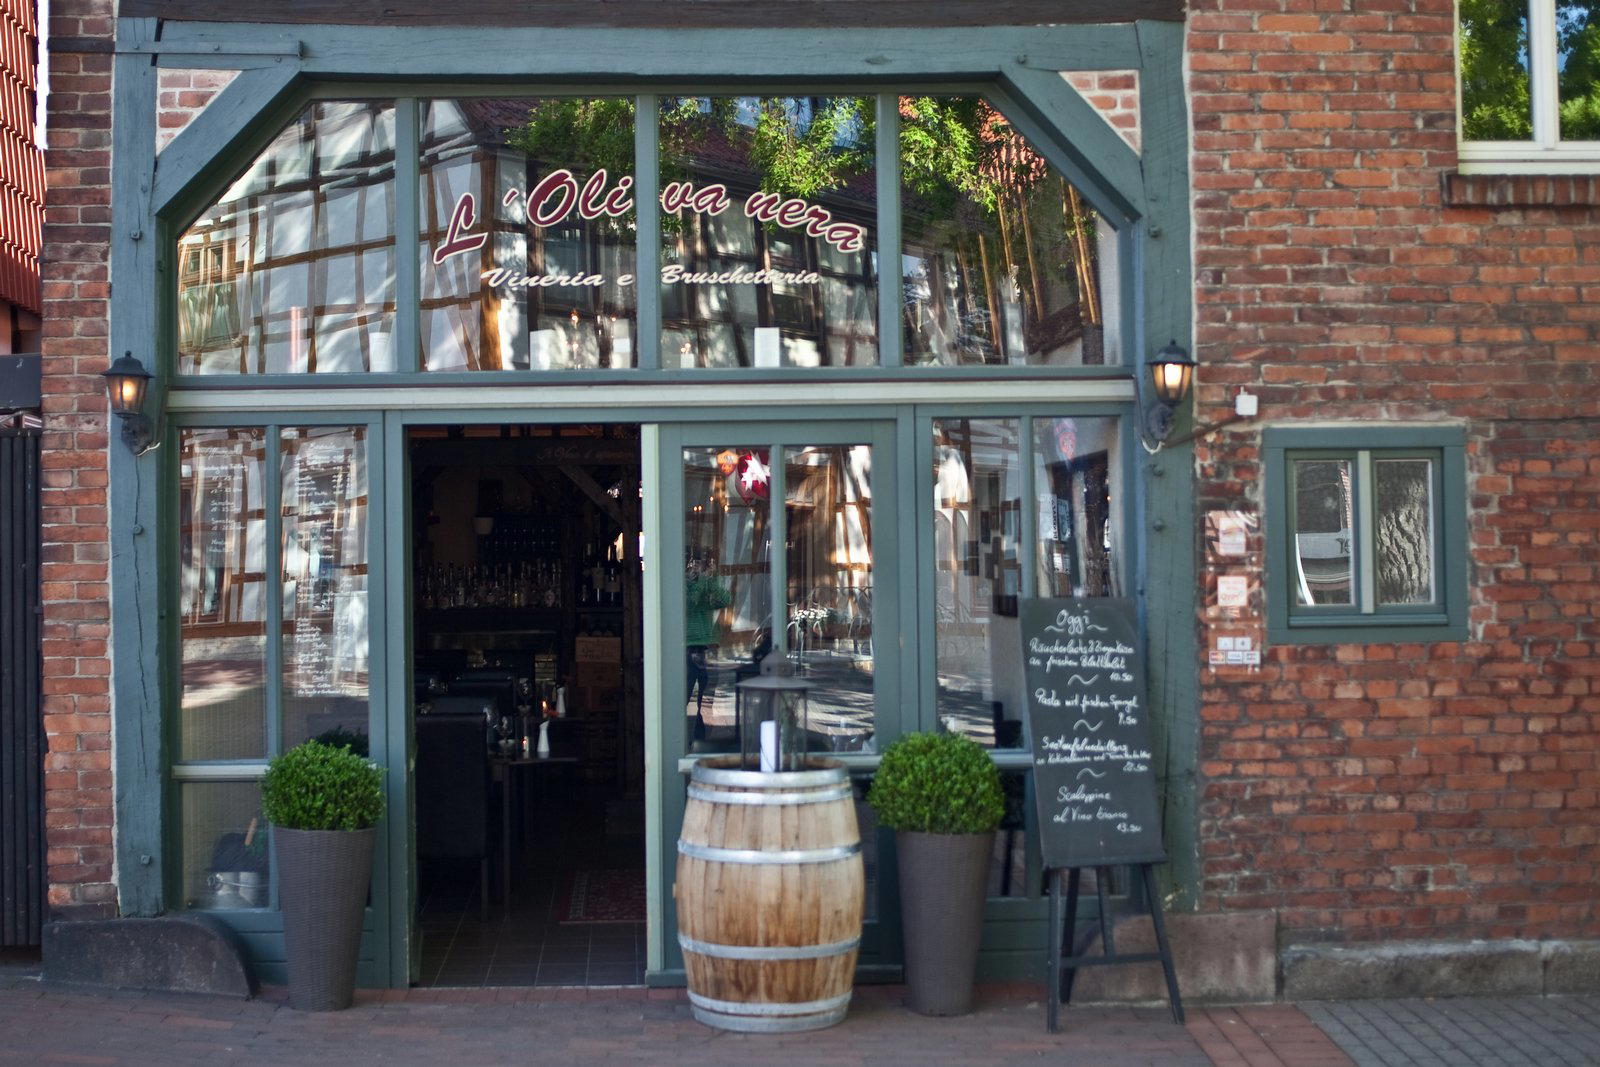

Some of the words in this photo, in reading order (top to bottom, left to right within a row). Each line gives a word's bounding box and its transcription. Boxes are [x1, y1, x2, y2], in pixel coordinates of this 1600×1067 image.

[744, 190, 866, 253] nera
[480, 267, 605, 288] Vineria
[616, 274, 634, 288] e
[660, 265, 820, 286] Bruschetteria
[1056, 609, 1090, 635] Oggi
[1035, 688, 1061, 707] Pasta
[1065, 693, 1079, 706] mit
[1071, 806, 1092, 821] Vino
